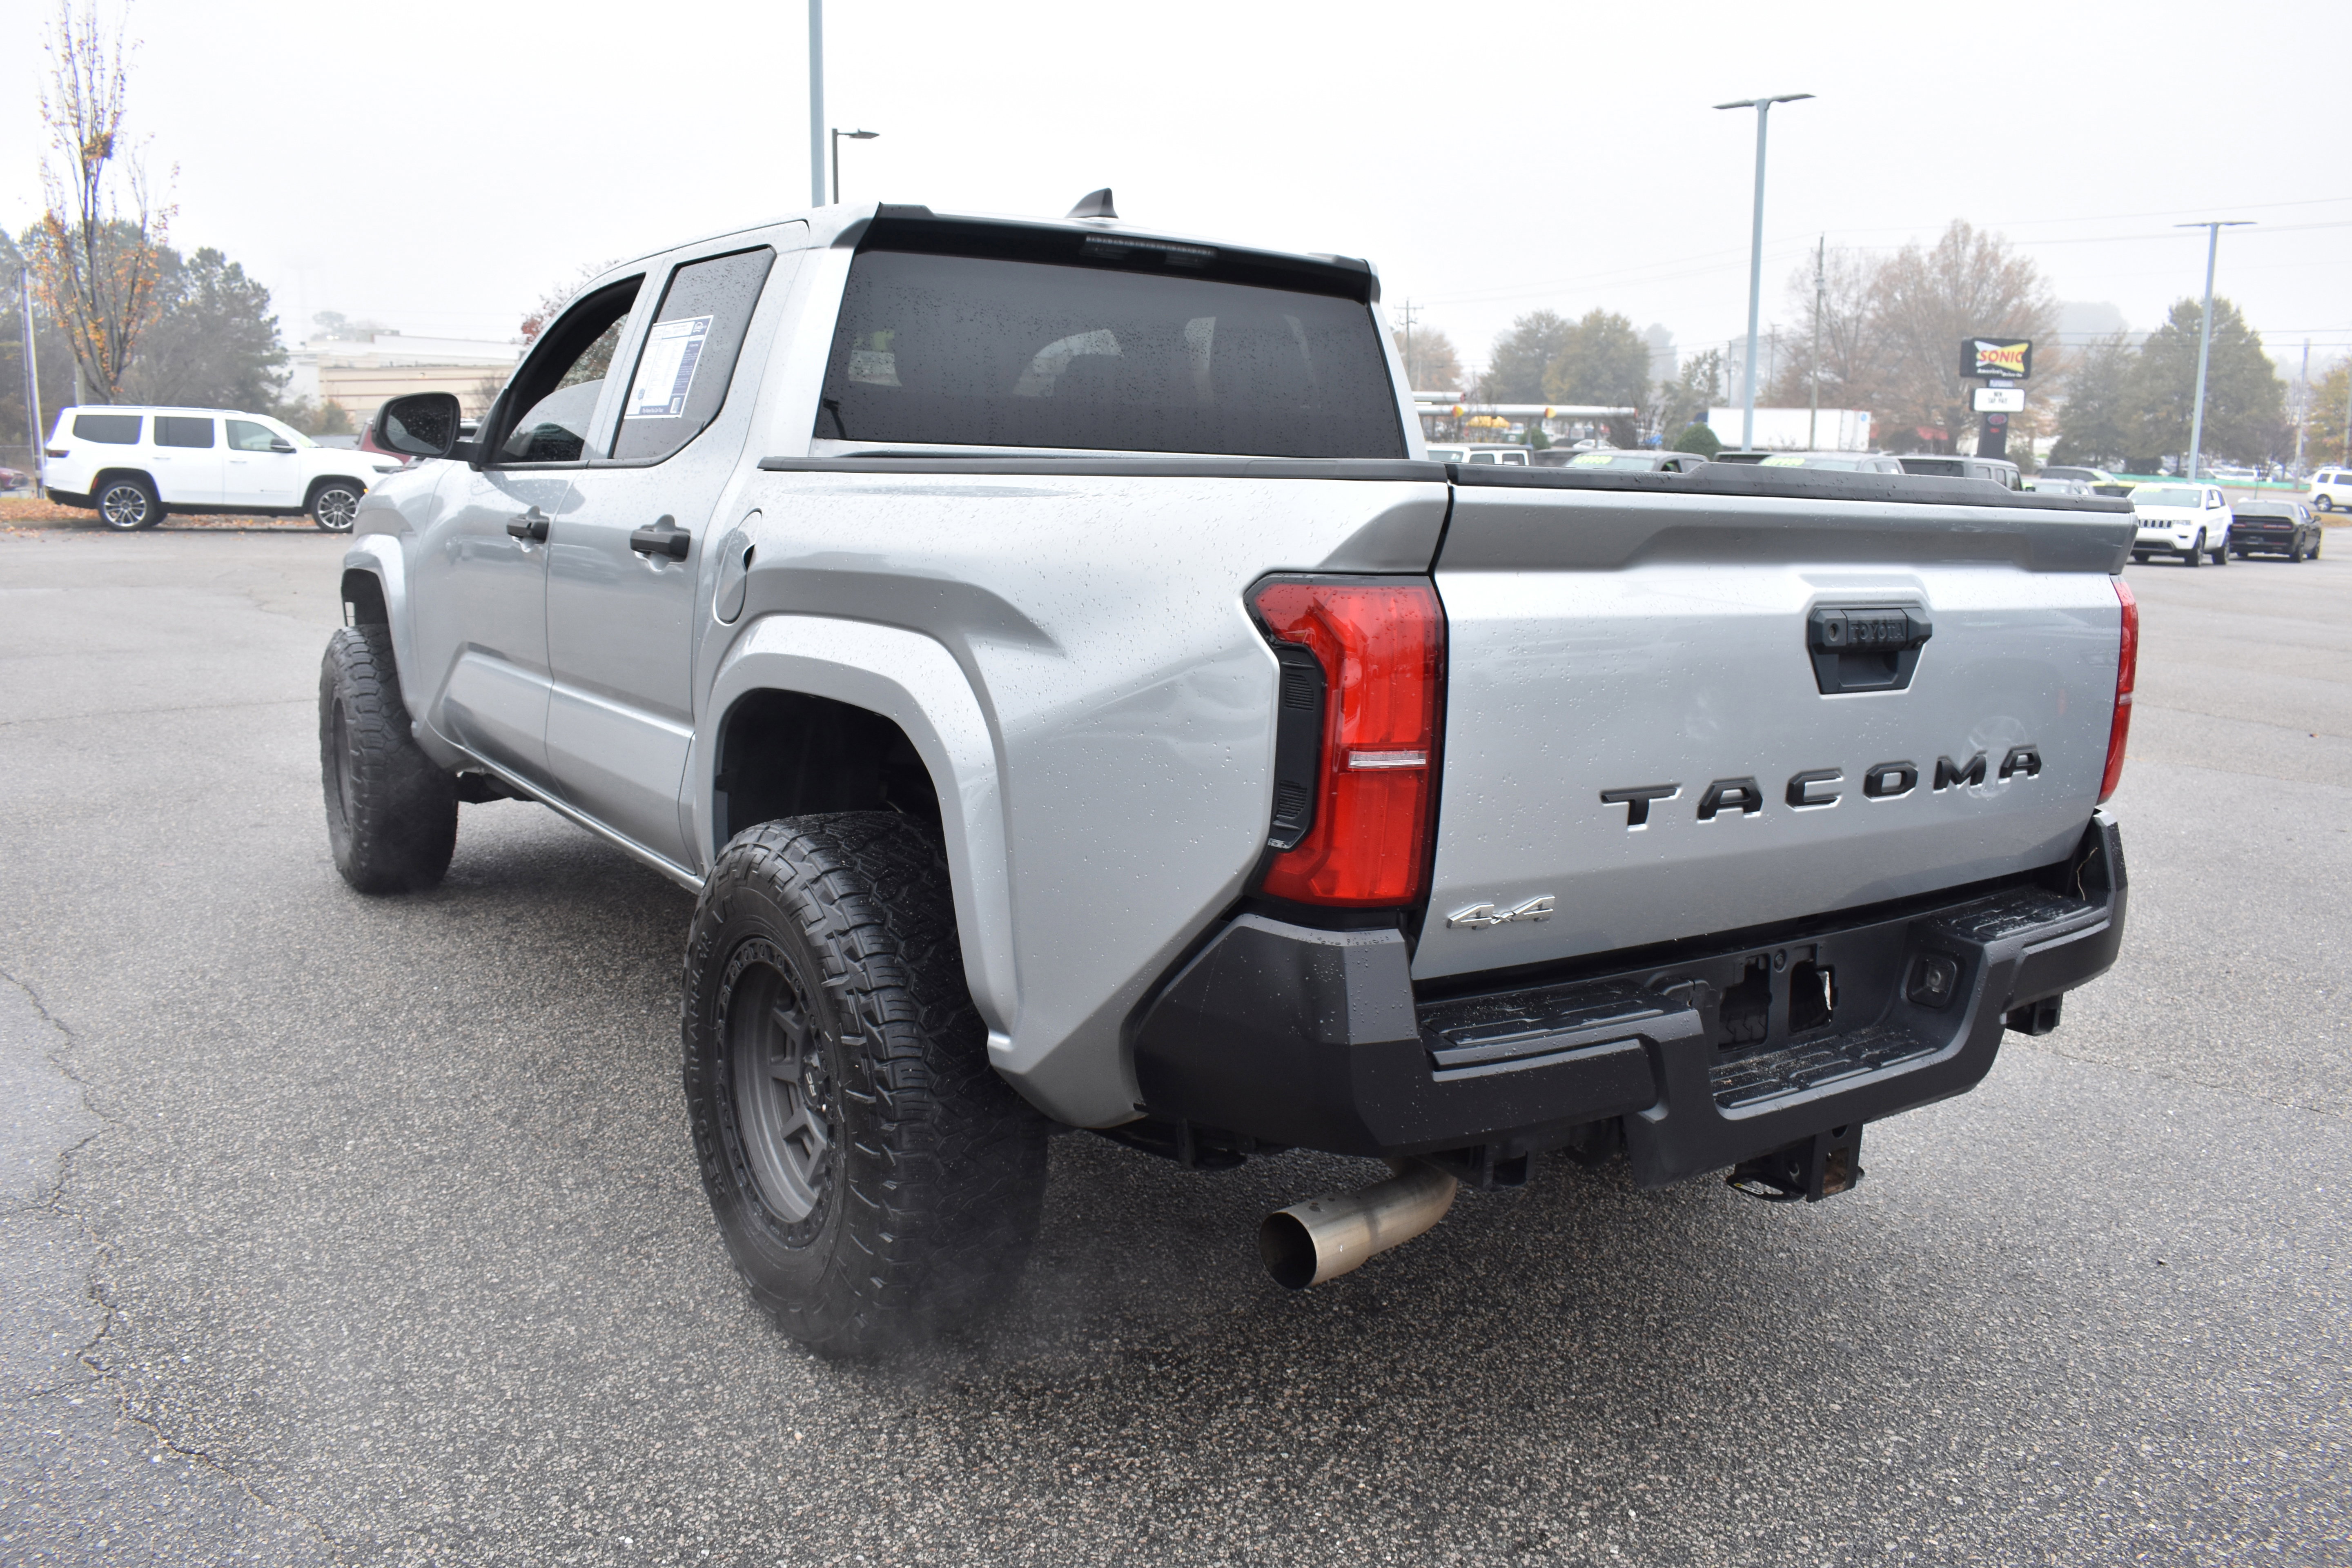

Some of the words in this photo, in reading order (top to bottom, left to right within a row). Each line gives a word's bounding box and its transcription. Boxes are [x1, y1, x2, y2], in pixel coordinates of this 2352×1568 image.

[1979, 350, 2024, 363] SONIC
[1851, 622, 1904, 640] TOYOTA
[1600, 744, 2042, 829] TACOMA
